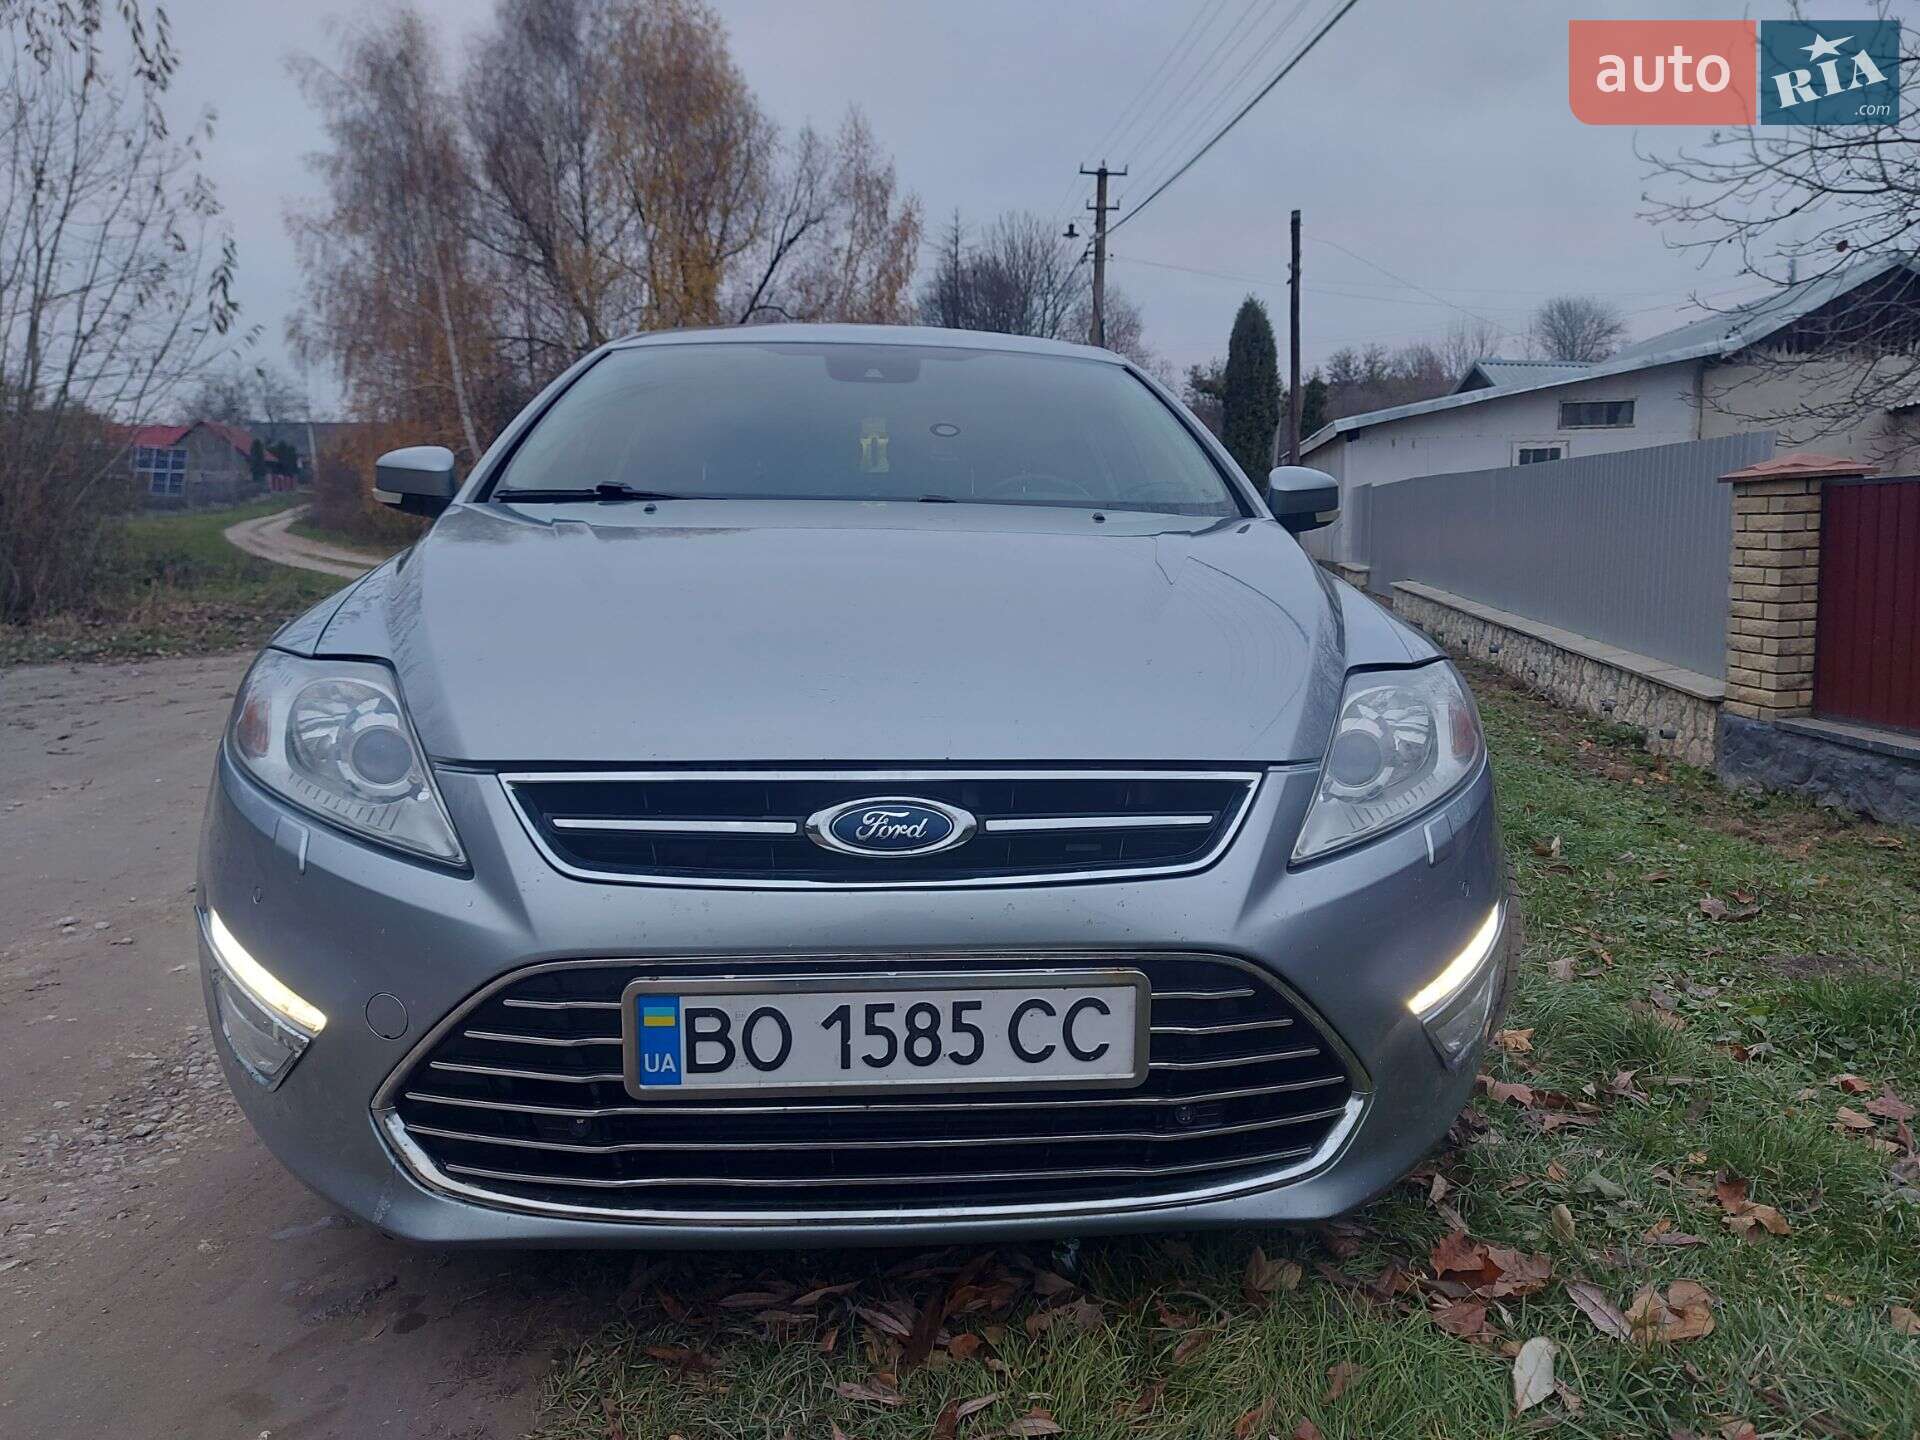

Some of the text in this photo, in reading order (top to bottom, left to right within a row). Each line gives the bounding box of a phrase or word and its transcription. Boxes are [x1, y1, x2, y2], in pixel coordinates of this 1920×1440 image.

[855, 811, 929, 842] Ford
[684, 997, 1111, 1074] BO 1585 CC
[643, 1053, 677, 1073] UA
